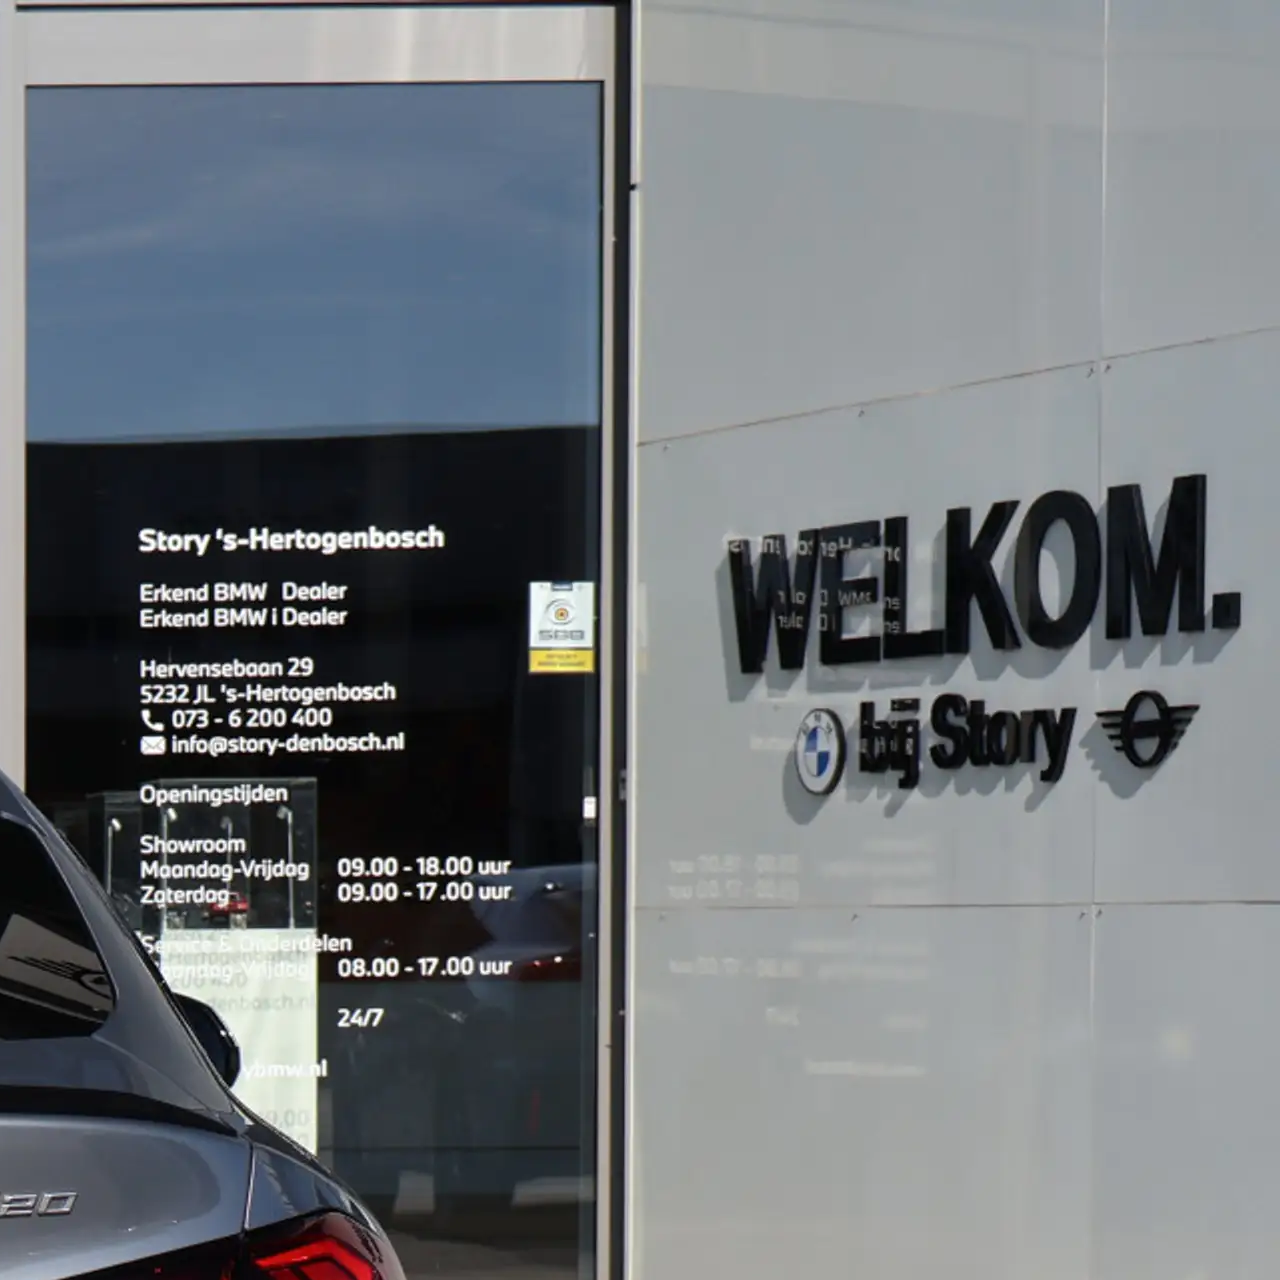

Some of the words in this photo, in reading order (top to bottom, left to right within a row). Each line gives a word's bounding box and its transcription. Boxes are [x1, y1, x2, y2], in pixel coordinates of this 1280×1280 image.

[138, 529, 211, 555] Story
[728, 474, 1241, 674] WELKOM.
[139, 583, 209, 603] Erkend
[213, 582, 268, 602] BMW
[282, 581, 348, 601] Dealer
[139, 608, 210, 628] Erkend
[213, 607, 268, 627] BMW
[271, 607, 278, 626] i
[282, 606, 348, 626] Dealer
[140, 659, 284, 679] Hervensebaan
[287, 657, 314, 677] 29
[140, 684, 190, 704] 5232
[192, 684, 217, 704] JL
[220, 682, 397, 706] 's-Hertogenbosch
[171, 708, 209, 729] 073
[228, 708, 242, 728] 6
[246, 707, 287, 728] 200
[290, 707, 333, 727] 400
[171, 731, 405, 757] info@story-denbosch.nl
[860, 698, 921, 789] bij
[930, 693, 1077, 782] Story
[139, 784, 289, 807] Openingstijden
[139, 834, 246, 855] Showroom
[140, 858, 310, 882] Maandag-Vrijdag
[337, 857, 399, 877] 09.00
[415, 856, 474, 876] 18.00
[477, 860, 512, 875] uur
[139, 885, 231, 908] Zaterdag
[337, 882, 399, 902] 09.00
[415, 881, 474, 902] 17.00
[478, 885, 513, 901] uur
[141, 936, 212, 953] Service
[219, 935, 236, 953] &
[240, 934, 352, 952] Onderdelen
[161, 959, 309, 983] aandag-Vrijdag
[337, 958, 400, 978] 08.00
[417, 956, 475, 977] 17.00
[478, 960, 513, 976] uur
[337, 1007, 385, 1028] 24/7
